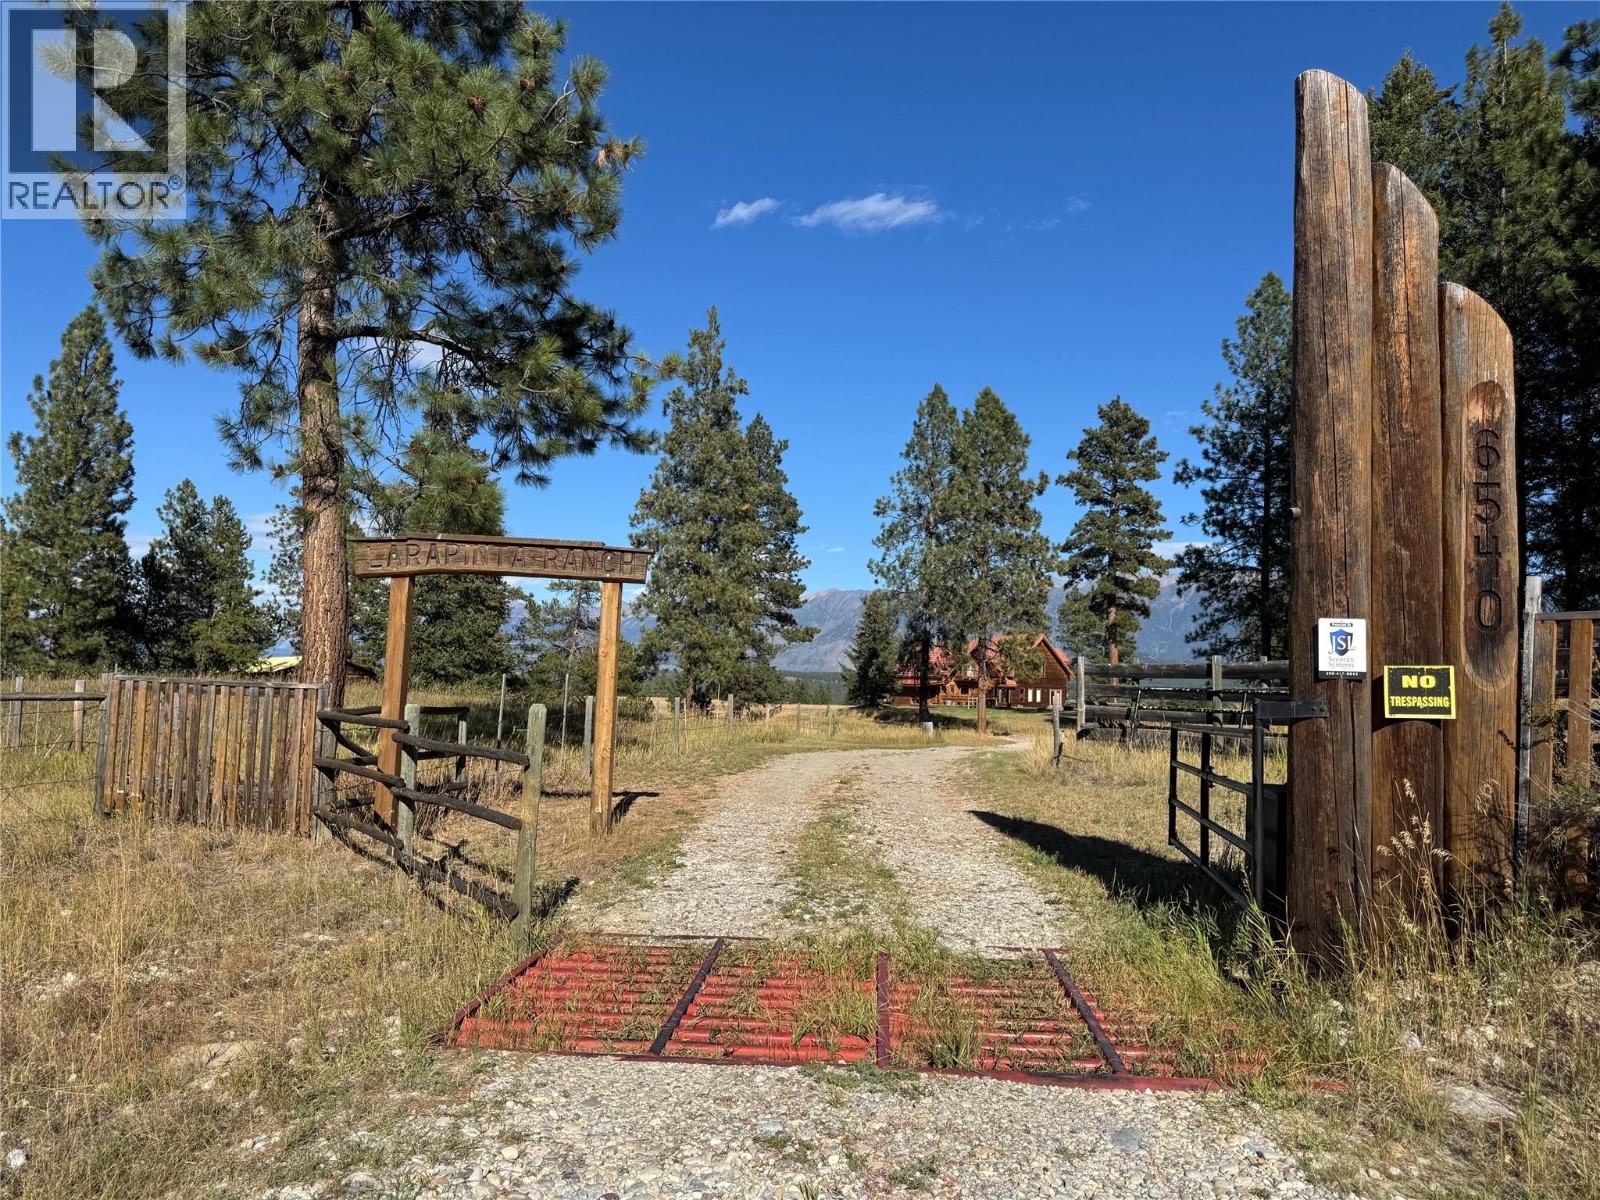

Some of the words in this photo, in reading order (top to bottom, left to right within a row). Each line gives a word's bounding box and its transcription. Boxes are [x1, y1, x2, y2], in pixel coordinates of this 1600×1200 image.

[367, 543, 527, 567] LARAPINTA
[543, 548, 635, 575] RANCH
[1401, 675, 1436, 689] NO
[1390, 696, 1450, 708] TRESPASSING
